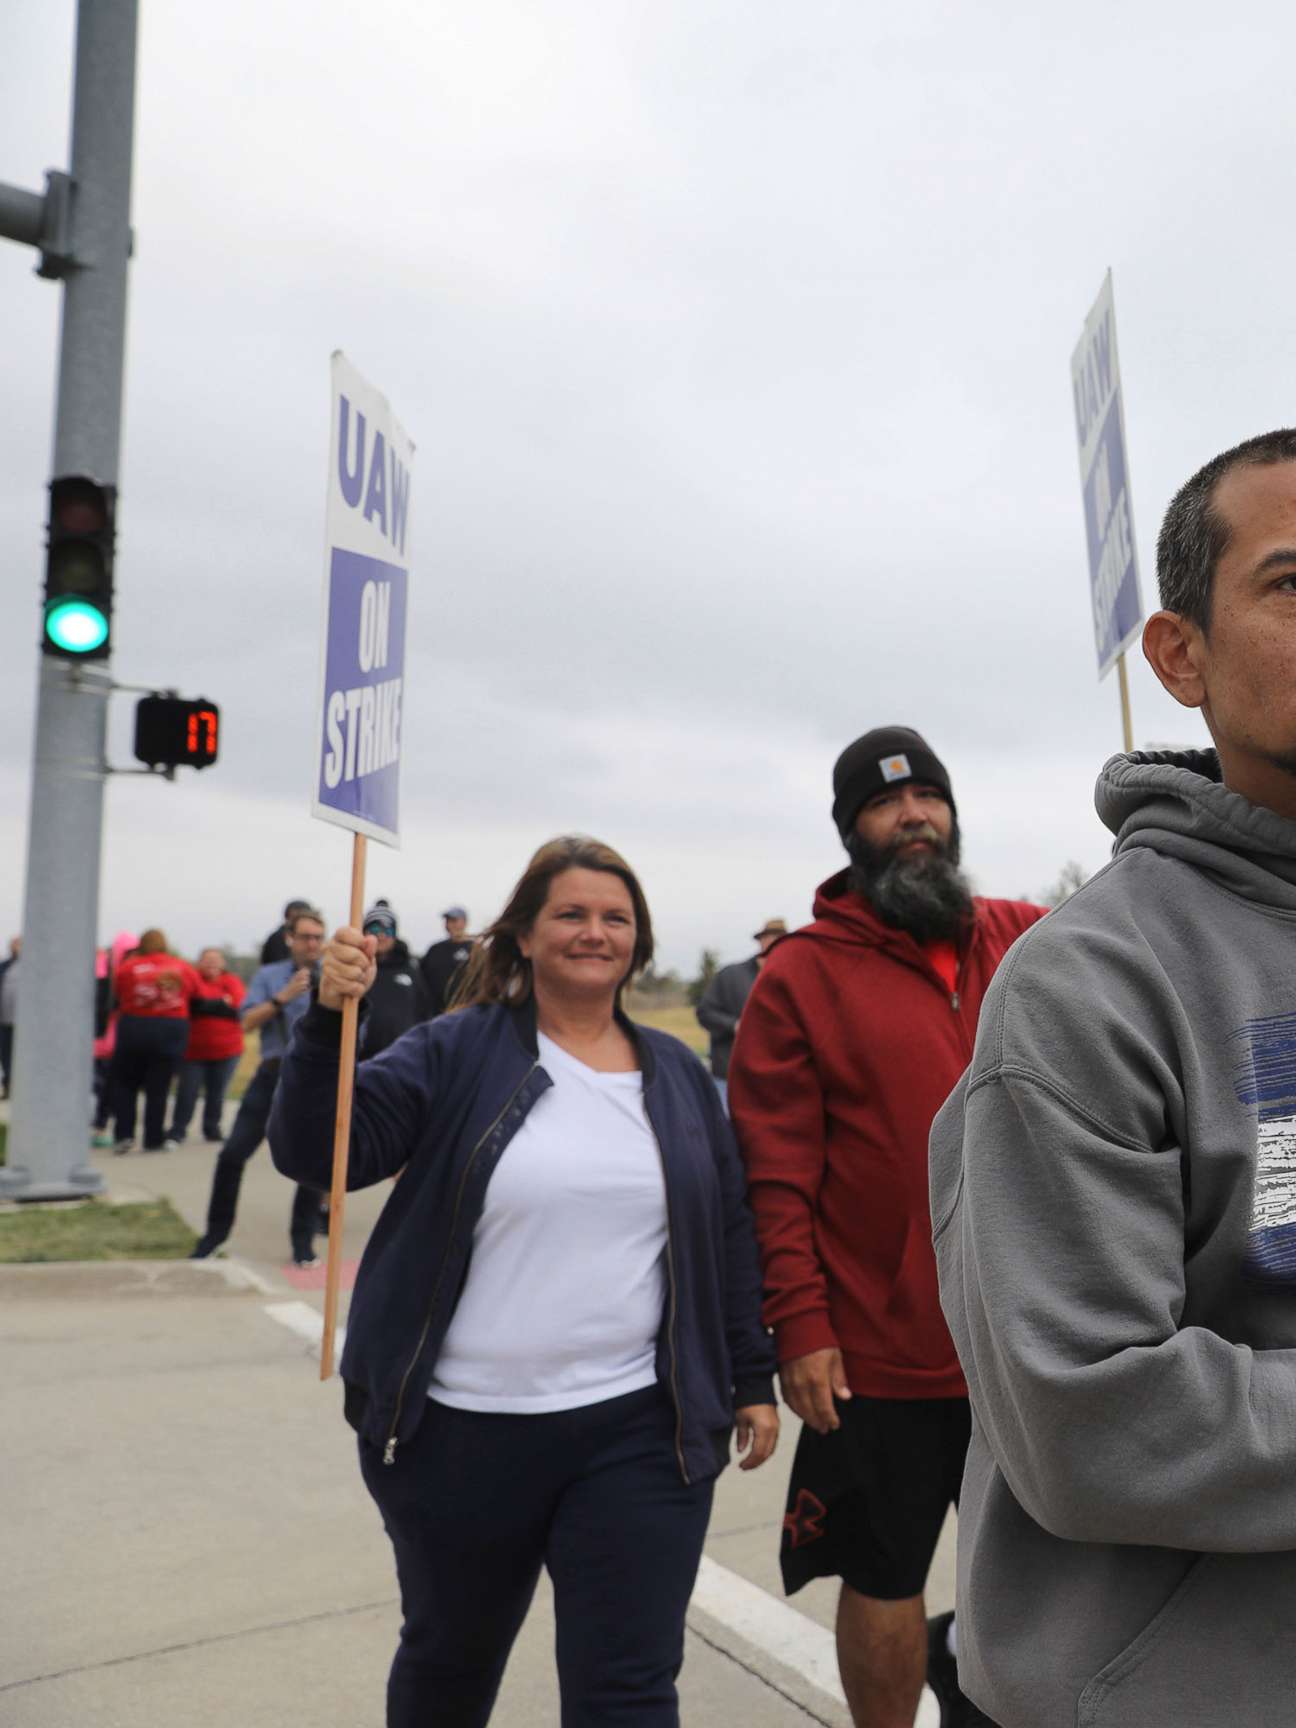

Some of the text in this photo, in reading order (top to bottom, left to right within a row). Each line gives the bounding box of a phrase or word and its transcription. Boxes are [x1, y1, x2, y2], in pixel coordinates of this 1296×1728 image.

[338, 394, 410, 557] UAW
[358, 580, 391, 672] ON
[187, 711, 217, 753] 17
[323, 678, 401, 789] STRIKE
